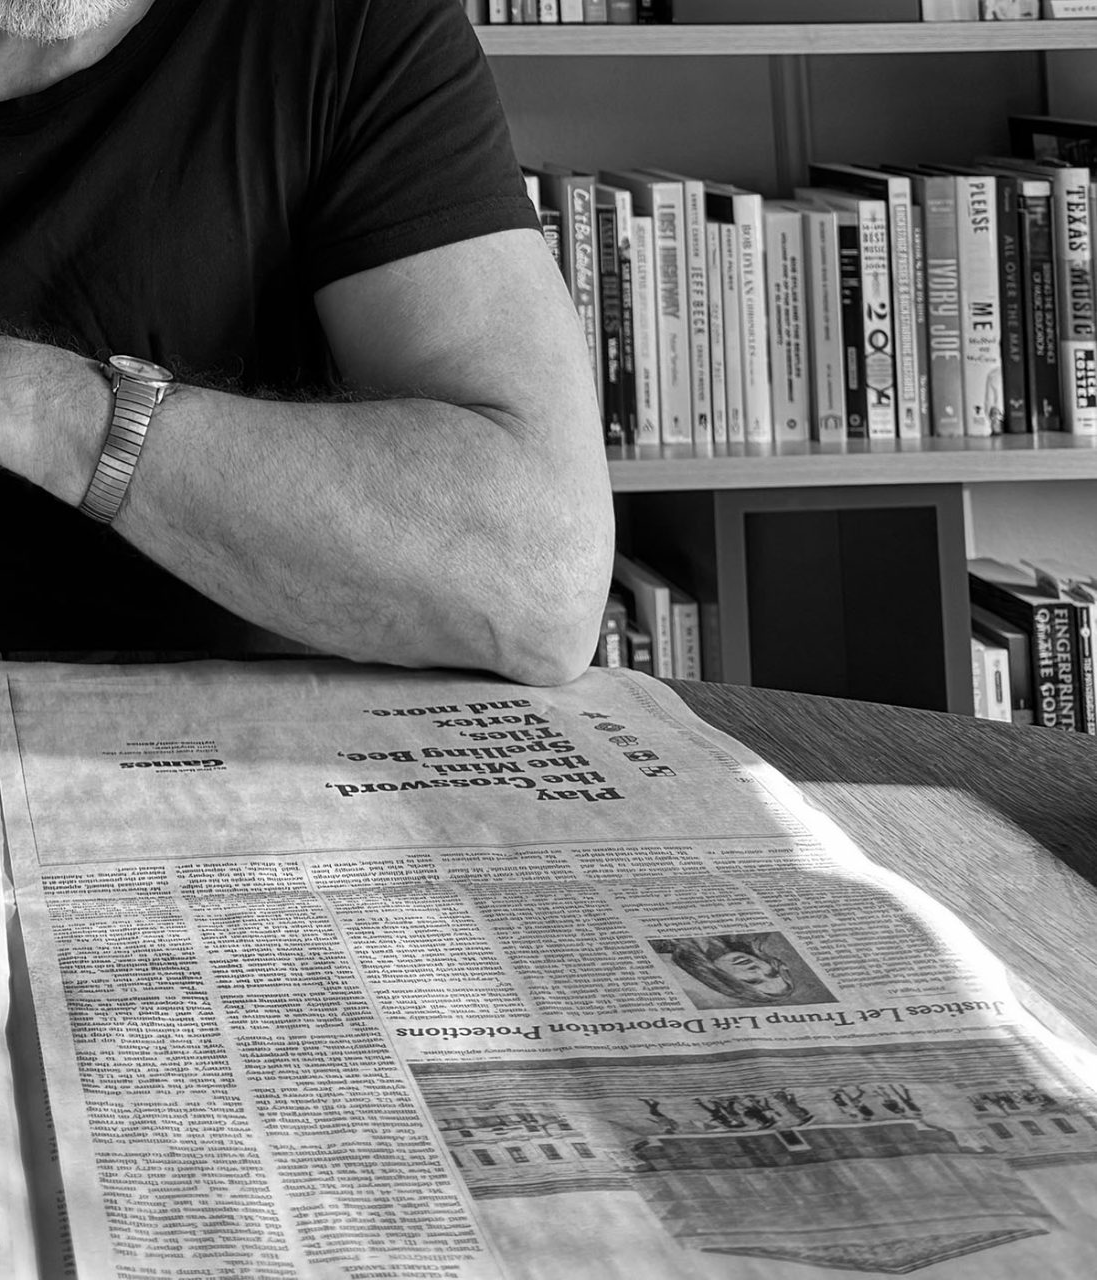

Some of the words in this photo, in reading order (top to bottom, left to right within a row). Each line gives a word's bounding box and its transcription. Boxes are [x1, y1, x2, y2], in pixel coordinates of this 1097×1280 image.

[968, 182, 989, 235] PLEASE
[1066, 185, 1087, 252] TEXAS
[691, 266, 705, 296] JEFF
[927, 259, 960, 317] IVORY
[1070, 267, 1093, 335] MUSIC
[693, 300, 706, 337] BECK
[971, 302, 994, 332] ME
[930, 324, 961, 361] JOE
[362, 705, 462, 718] more.
[465, 699, 532, 714] and
[431, 713, 549, 728] Vertex
[458, 726, 563, 742] Tiles,
[337, 750, 419, 763] Bee,
[421, 739, 576, 761] Spelling
[119, 759, 223, 769] Games
[421, 761, 525, 776] Mini,
[526, 754, 590, 769] the
[541, 771, 606, 785] the
[324, 776, 537, 797] Crossword,
[535, 786, 625, 802] Play
[859, 1007, 903, 1023] Let
[906, 1000, 1004, 1017] Justices
[712, 1015, 762, 1031] Lift
[765, 1010, 856, 1026] Trump
[395, 1024, 542, 1041] Protections
[547, 1017, 707, 1037] Deportation
